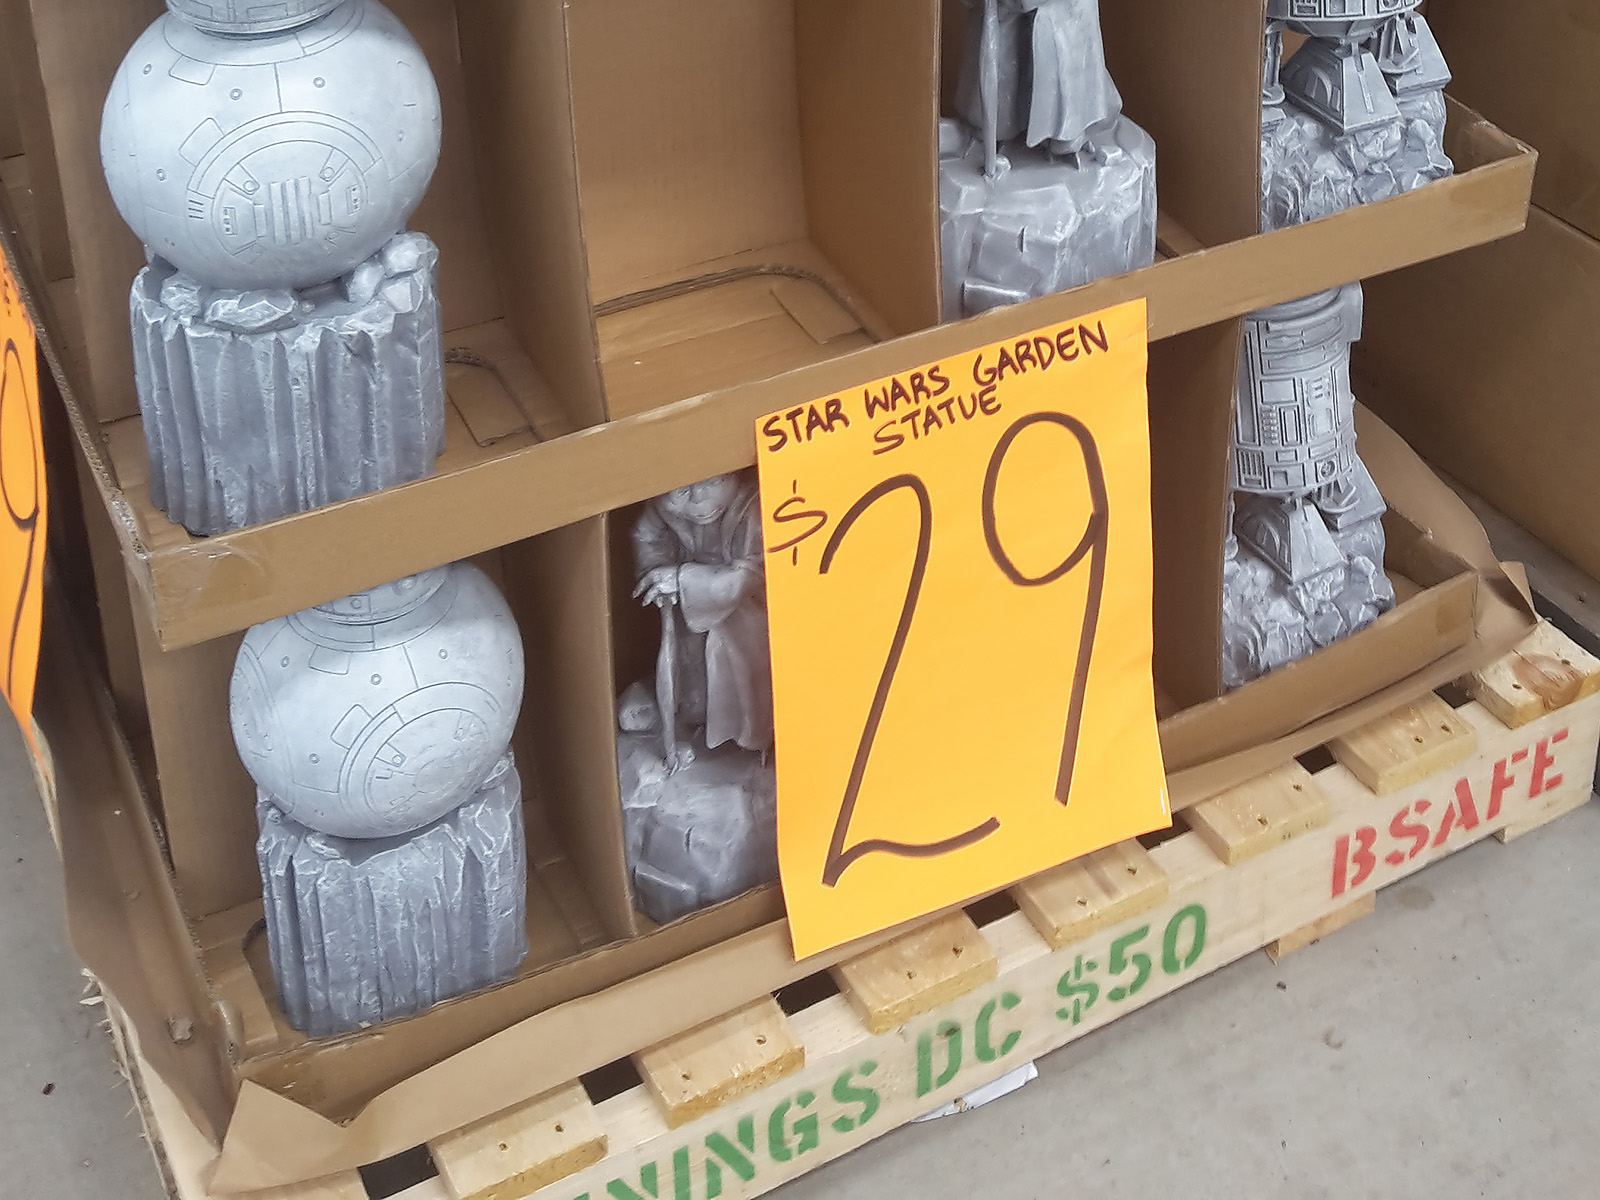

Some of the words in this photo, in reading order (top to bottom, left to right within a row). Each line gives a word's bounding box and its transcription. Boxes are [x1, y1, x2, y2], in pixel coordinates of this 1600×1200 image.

[763, 398, 851, 452] STAR
[863, 365, 951, 420] WARS
[973, 320, 1109, 387] GARDEN
[873, 385, 1002, 456] STATUE
[1331, 727, 1570, 900] BSAFE
[574, 1060, 881, 1200] INGS
[915, 991, 1023, 1099] DC
[1055, 902, 1208, 1026] $50
